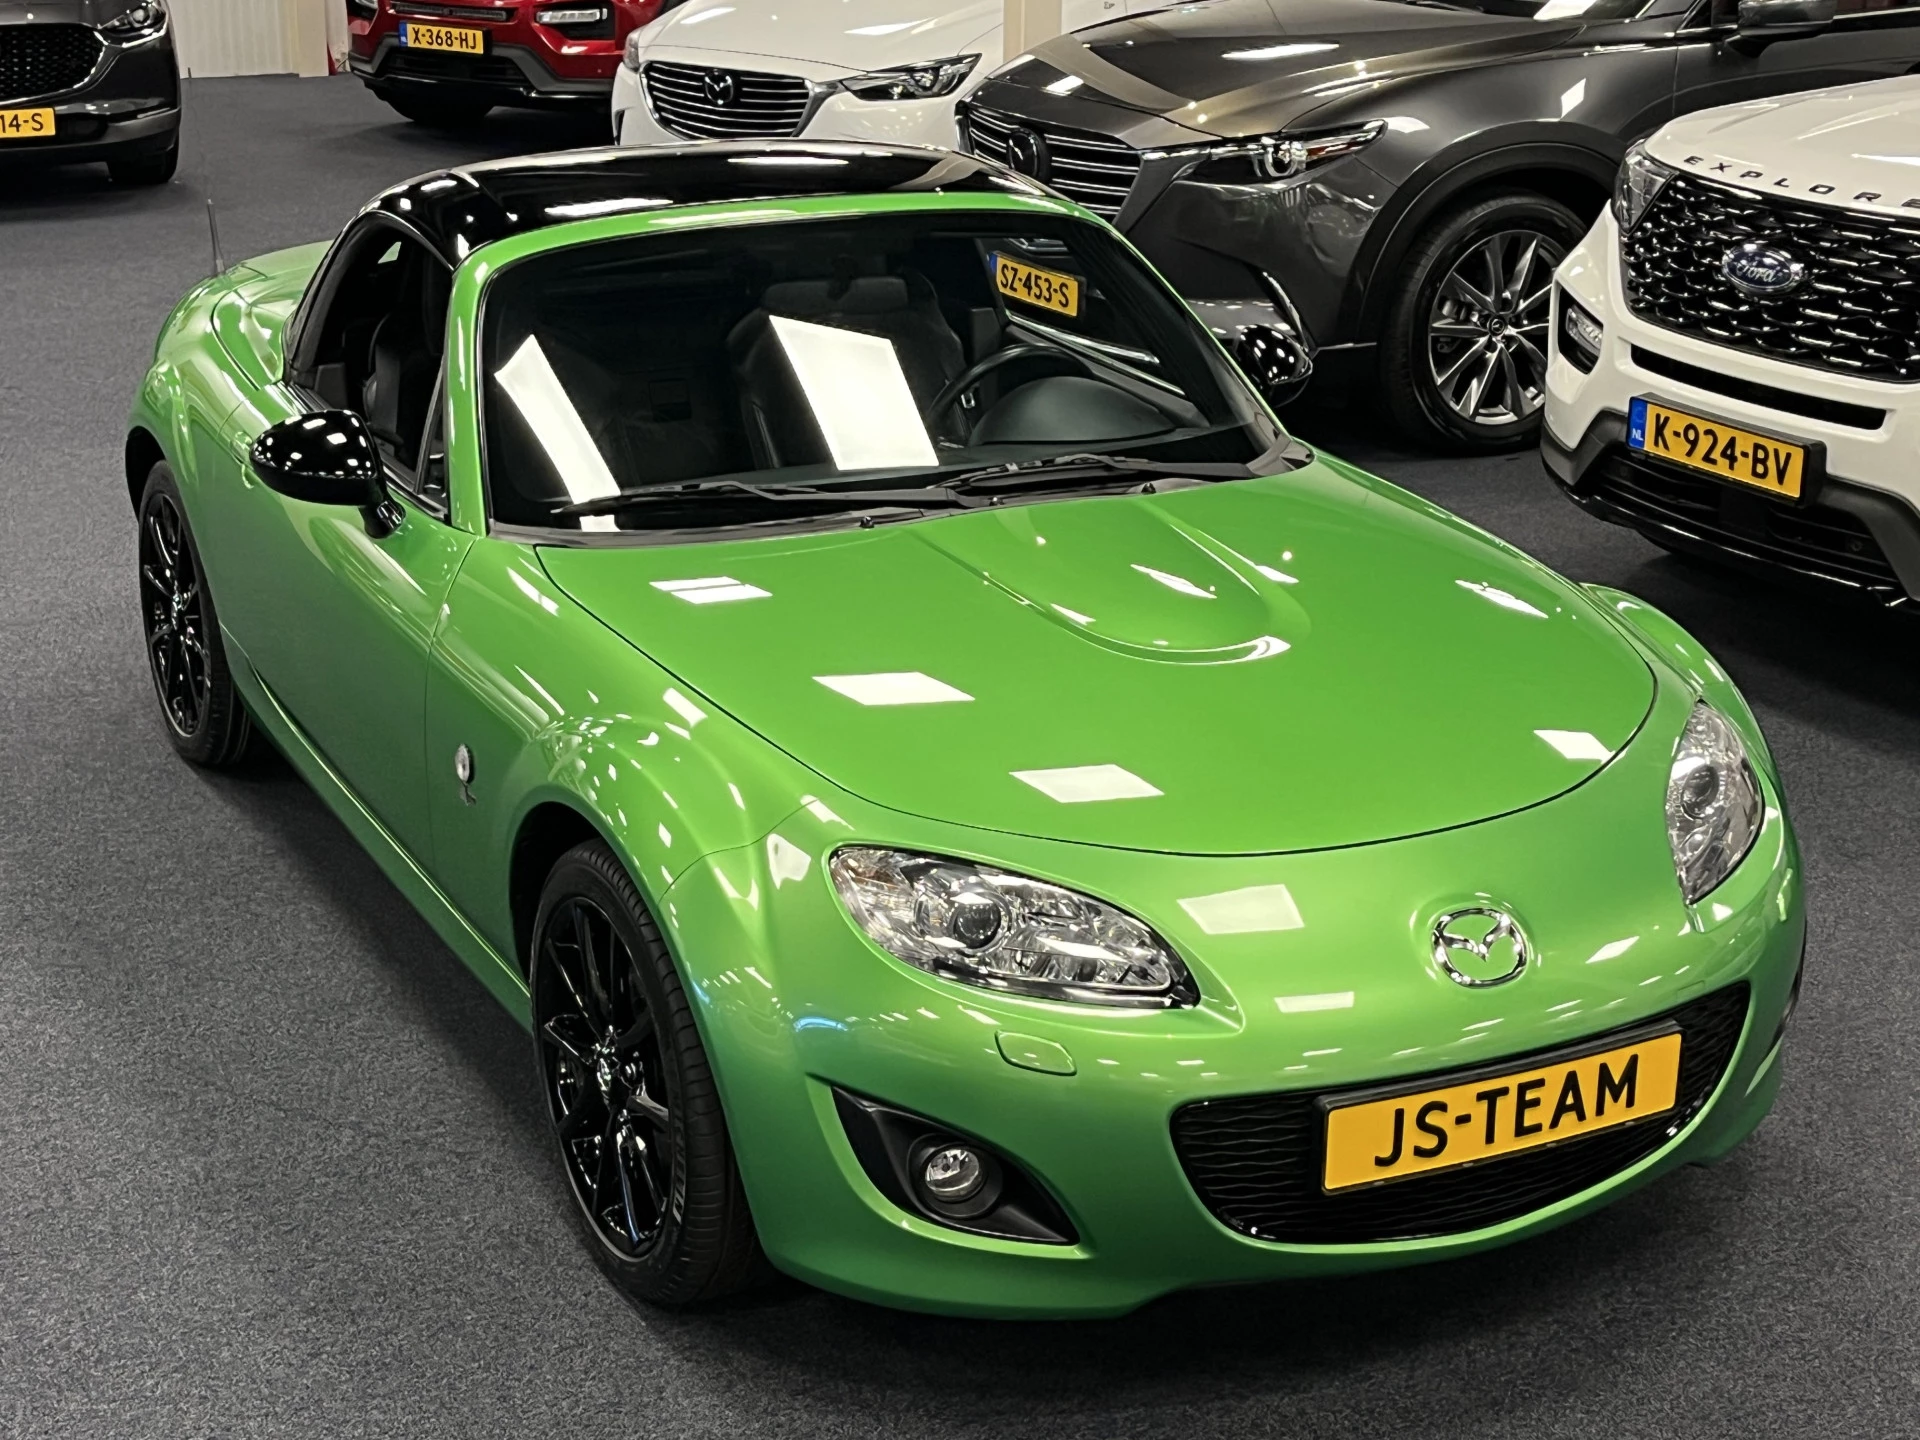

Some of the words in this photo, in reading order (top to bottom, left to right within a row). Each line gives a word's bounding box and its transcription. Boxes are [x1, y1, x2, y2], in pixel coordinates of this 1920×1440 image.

[412, 26, 477, 50] X-368-HJ
[0, 112, 44, 133] 14-S
[1000, 263, 1069, 308] SZ-453-S
[1632, 427, 1644, 441] NL
[1653, 412, 1792, 486] K-924-BV
[1374, 1053, 1639, 1167] JS-TEAM
